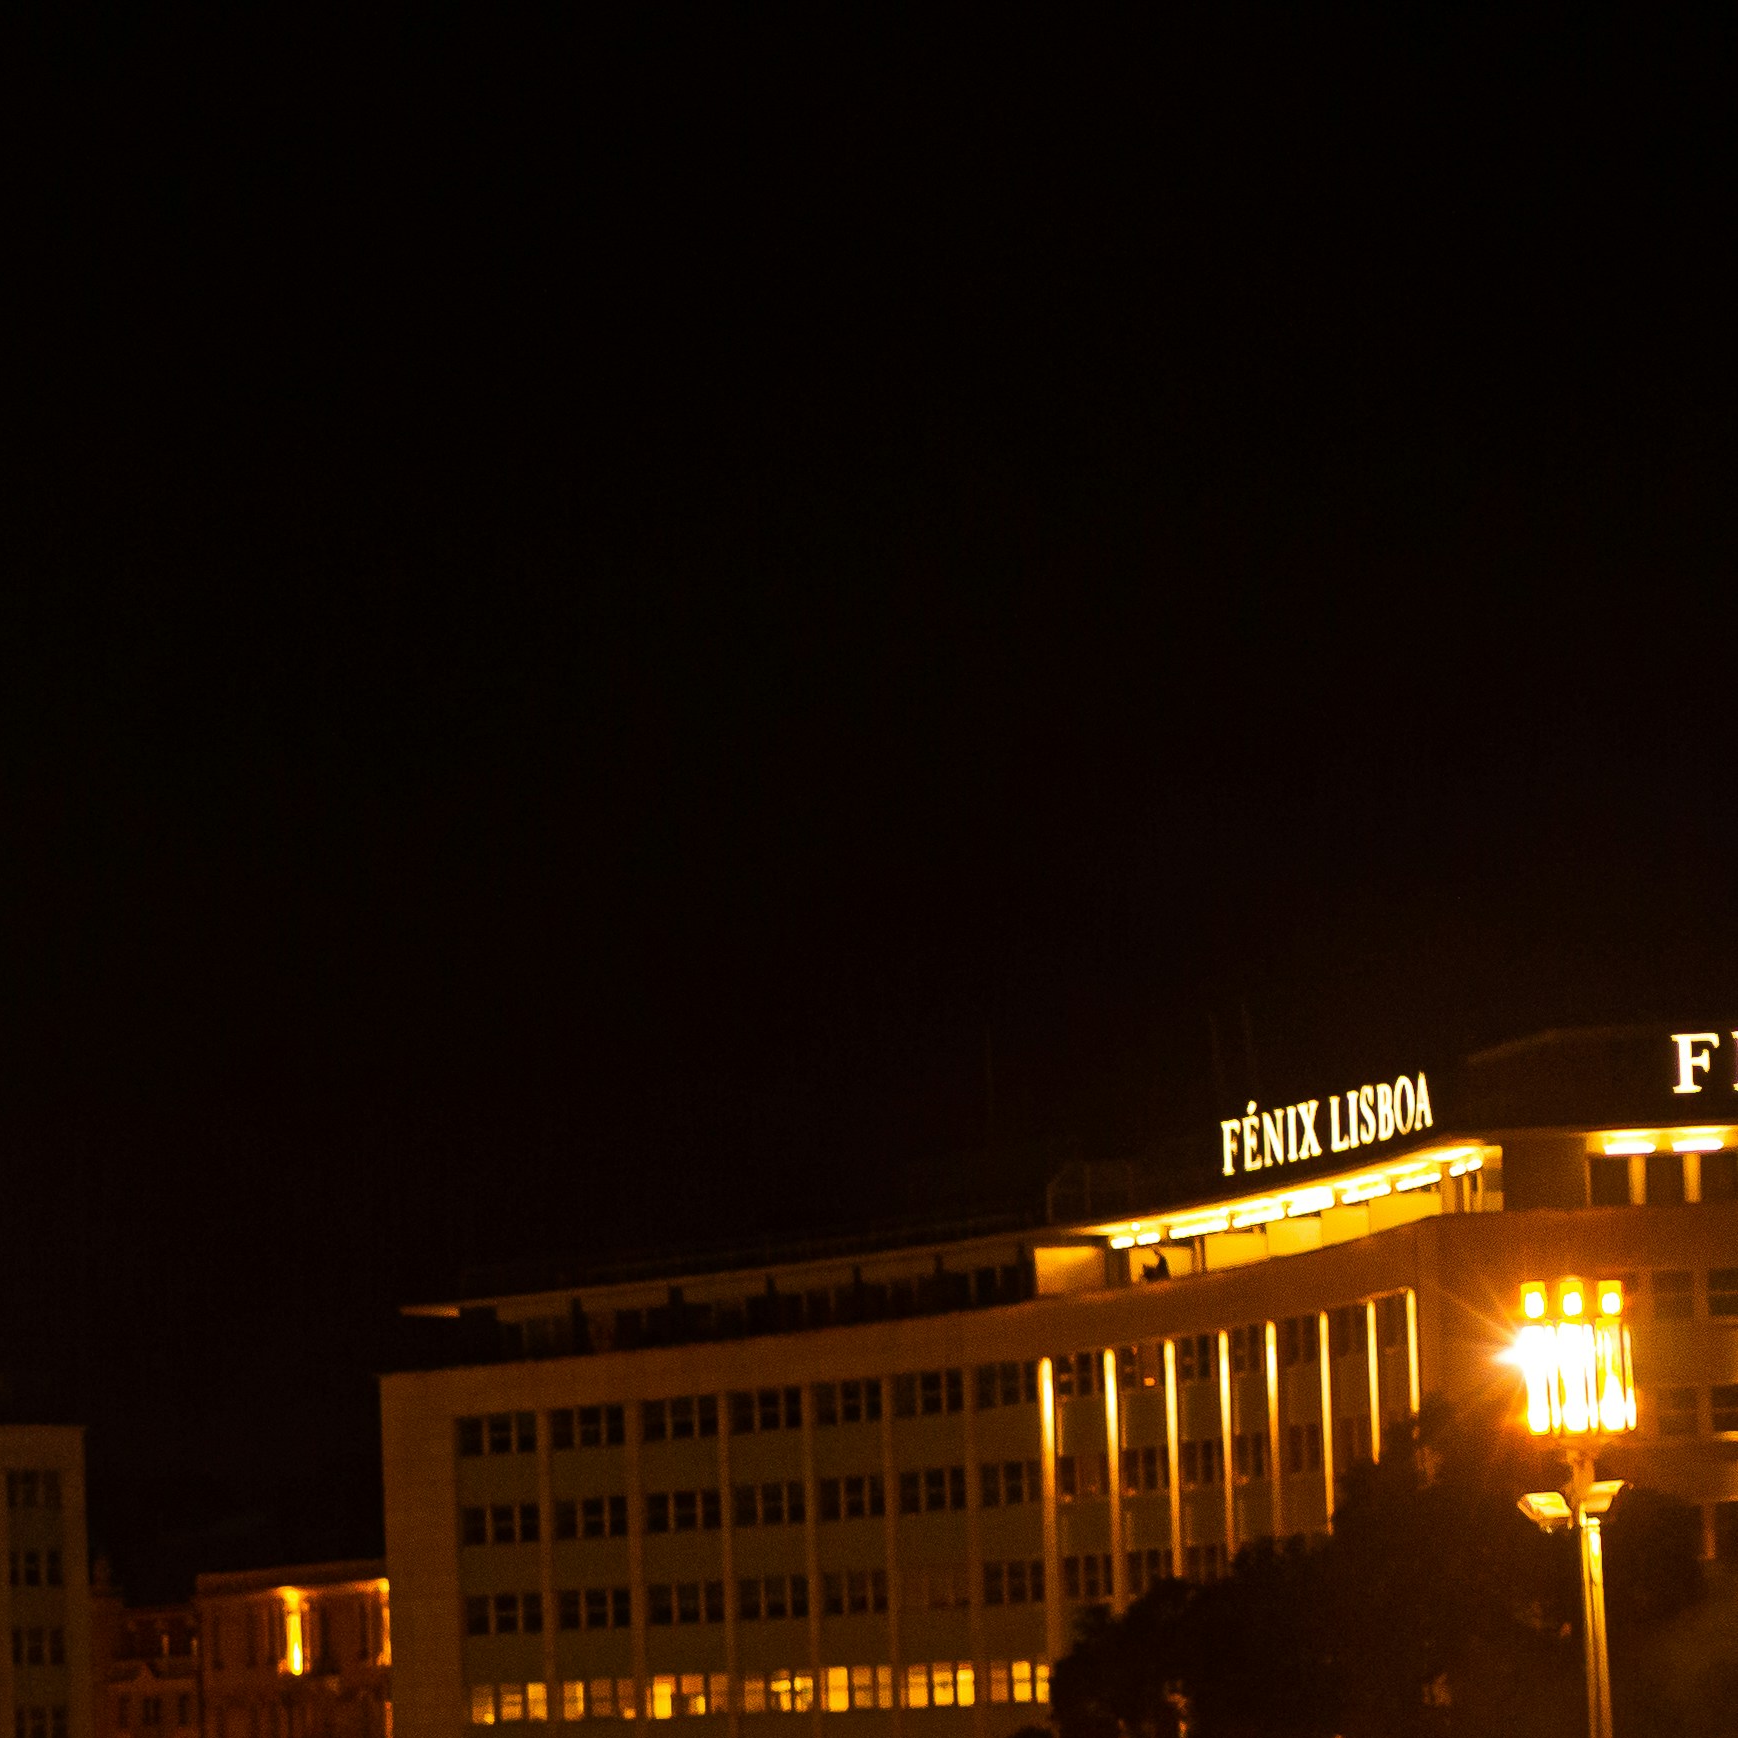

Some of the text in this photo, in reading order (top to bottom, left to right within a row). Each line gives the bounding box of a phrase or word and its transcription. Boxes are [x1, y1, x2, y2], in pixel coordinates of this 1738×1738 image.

[1670, 1031, 1738, 1094] F
[1220, 1071, 1434, 1176] FÉNIX LISBOA
